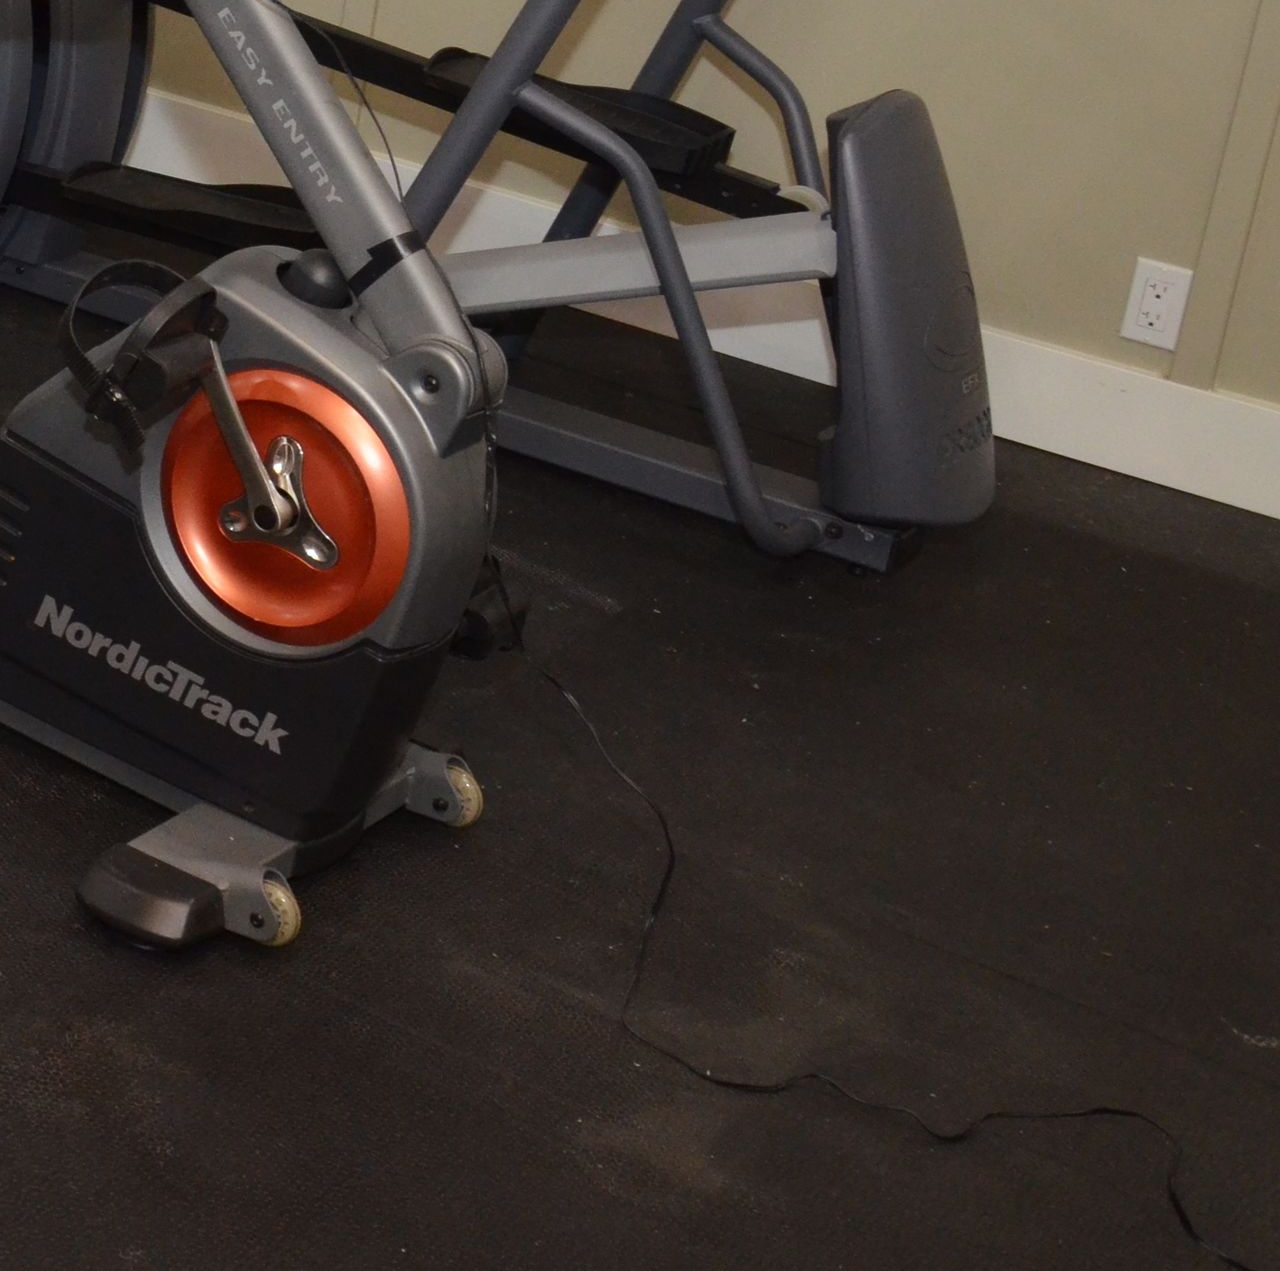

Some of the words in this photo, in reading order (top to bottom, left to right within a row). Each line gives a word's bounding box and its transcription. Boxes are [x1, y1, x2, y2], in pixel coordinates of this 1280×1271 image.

[217, 7, 273, 87] EASY
[271, 99, 343, 204] ENTRY
[33, 594, 289, 755] NordicTrack
